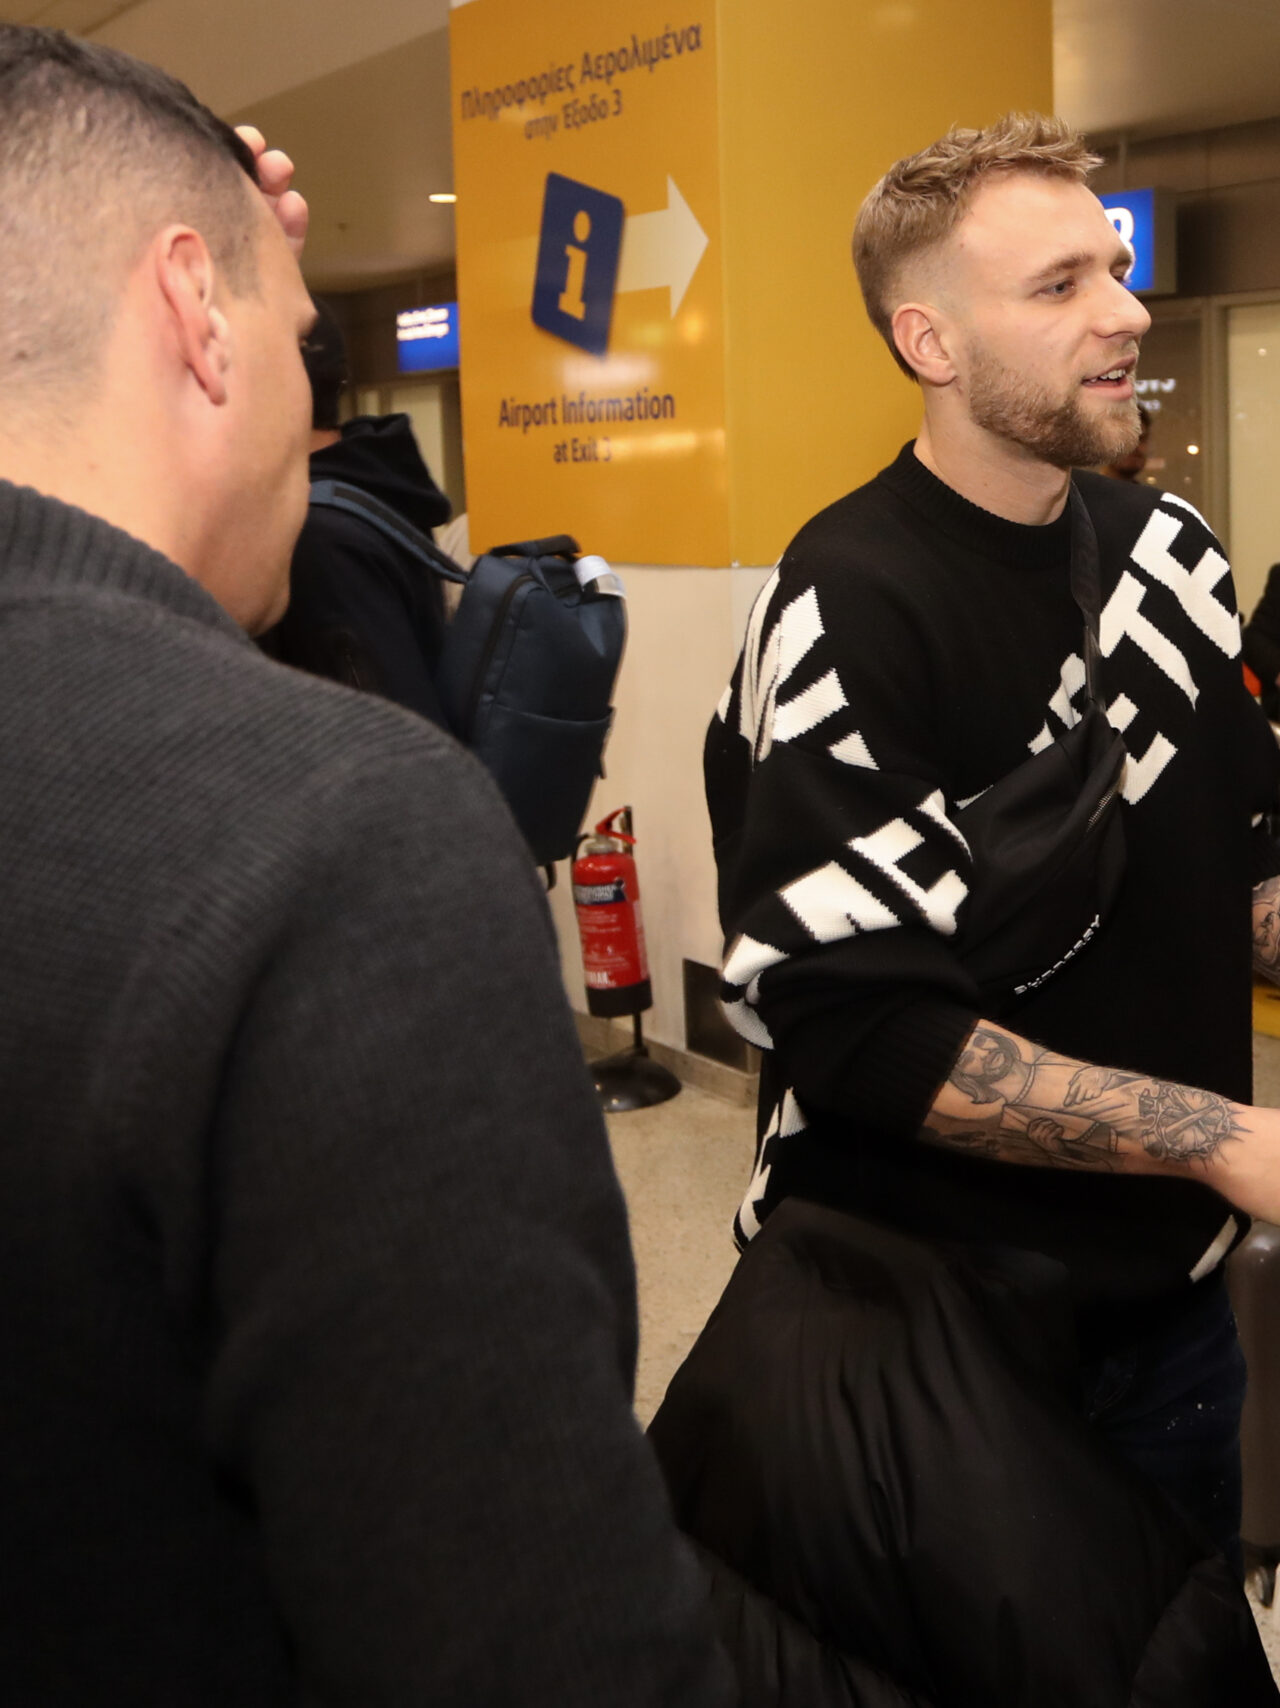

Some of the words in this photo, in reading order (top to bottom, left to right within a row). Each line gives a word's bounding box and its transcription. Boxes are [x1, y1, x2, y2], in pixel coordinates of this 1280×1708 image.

[460, 61, 575, 121] Πληροφορίες
[580, 22, 703, 86] Αερολιμένα
[612, 88, 622, 116] 3
[498, 396, 558, 435] Airport
[562, 386, 676, 425] Information
[553, 440, 569, 463] at
[571, 437, 599, 464] Exit
